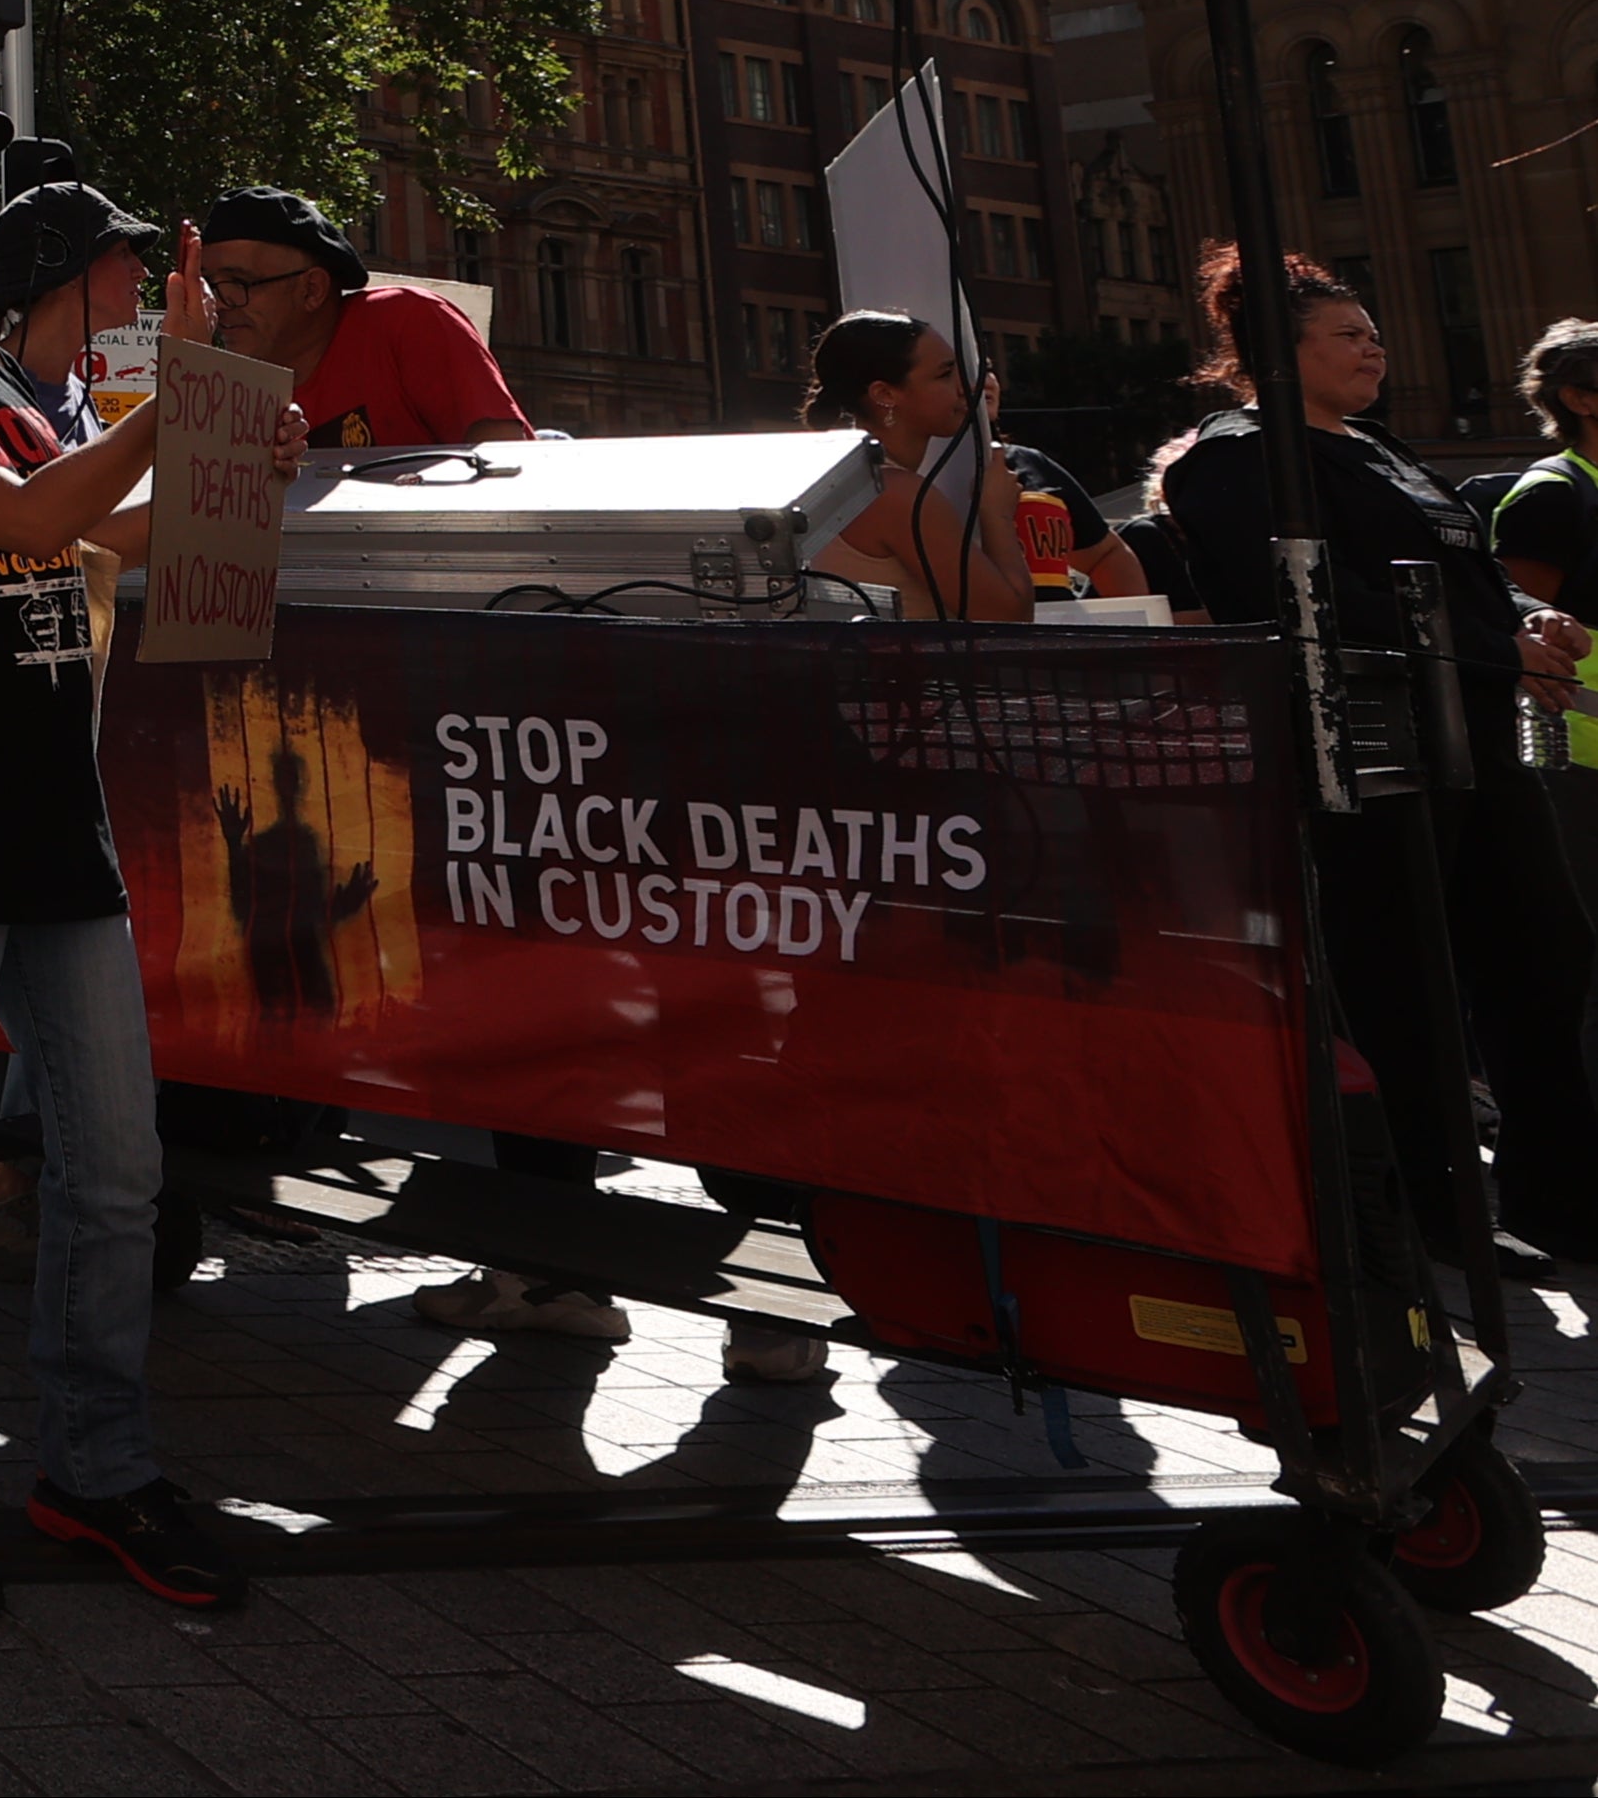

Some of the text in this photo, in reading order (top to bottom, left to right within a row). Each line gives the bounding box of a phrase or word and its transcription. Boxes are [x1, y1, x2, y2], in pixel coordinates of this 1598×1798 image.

[165, 357, 226, 434] STOP
[190, 452, 275, 531] DEATHS
[156, 554, 278, 638] IN CUSTODY!
[435, 713, 608, 785] STOP
[445, 787, 987, 891] BLACK DEATHS
[446, 861, 872, 962] IN CUSTODY
